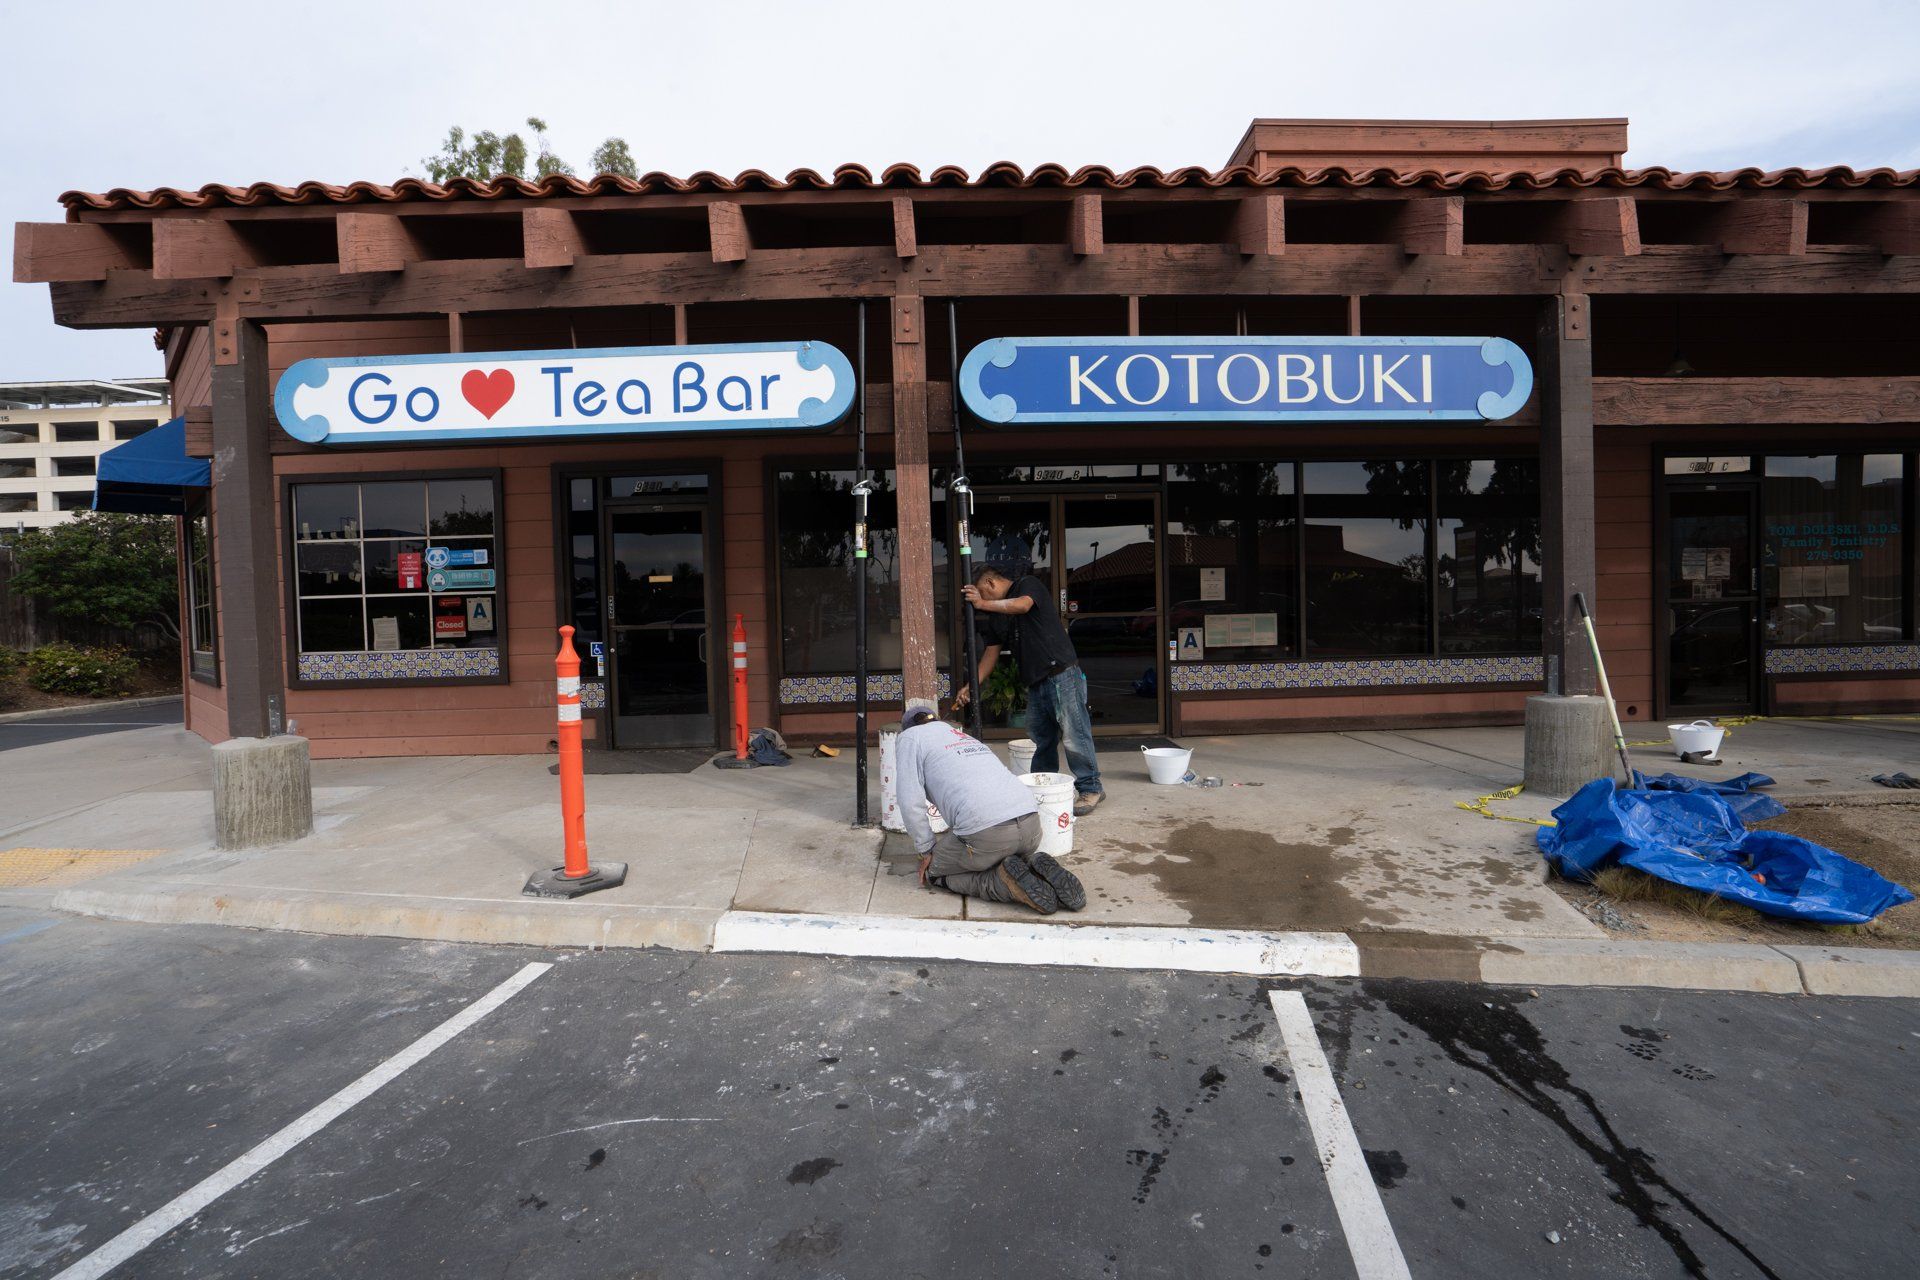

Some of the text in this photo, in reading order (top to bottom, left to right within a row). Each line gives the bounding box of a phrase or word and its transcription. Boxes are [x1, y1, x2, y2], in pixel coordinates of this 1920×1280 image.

[1069, 352, 1433, 406] KOTOBUKI
[347, 361, 782, 425] Go Tea Bar
[1036, 470, 1080, 480] 9340 B
[1768, 525, 1796, 536] TOM
[1781, 536, 1887, 548] Family Dentistry
[473, 603, 487, 618] A
[436, 619, 464, 629] Closed
[1184, 633, 1198, 648] A
